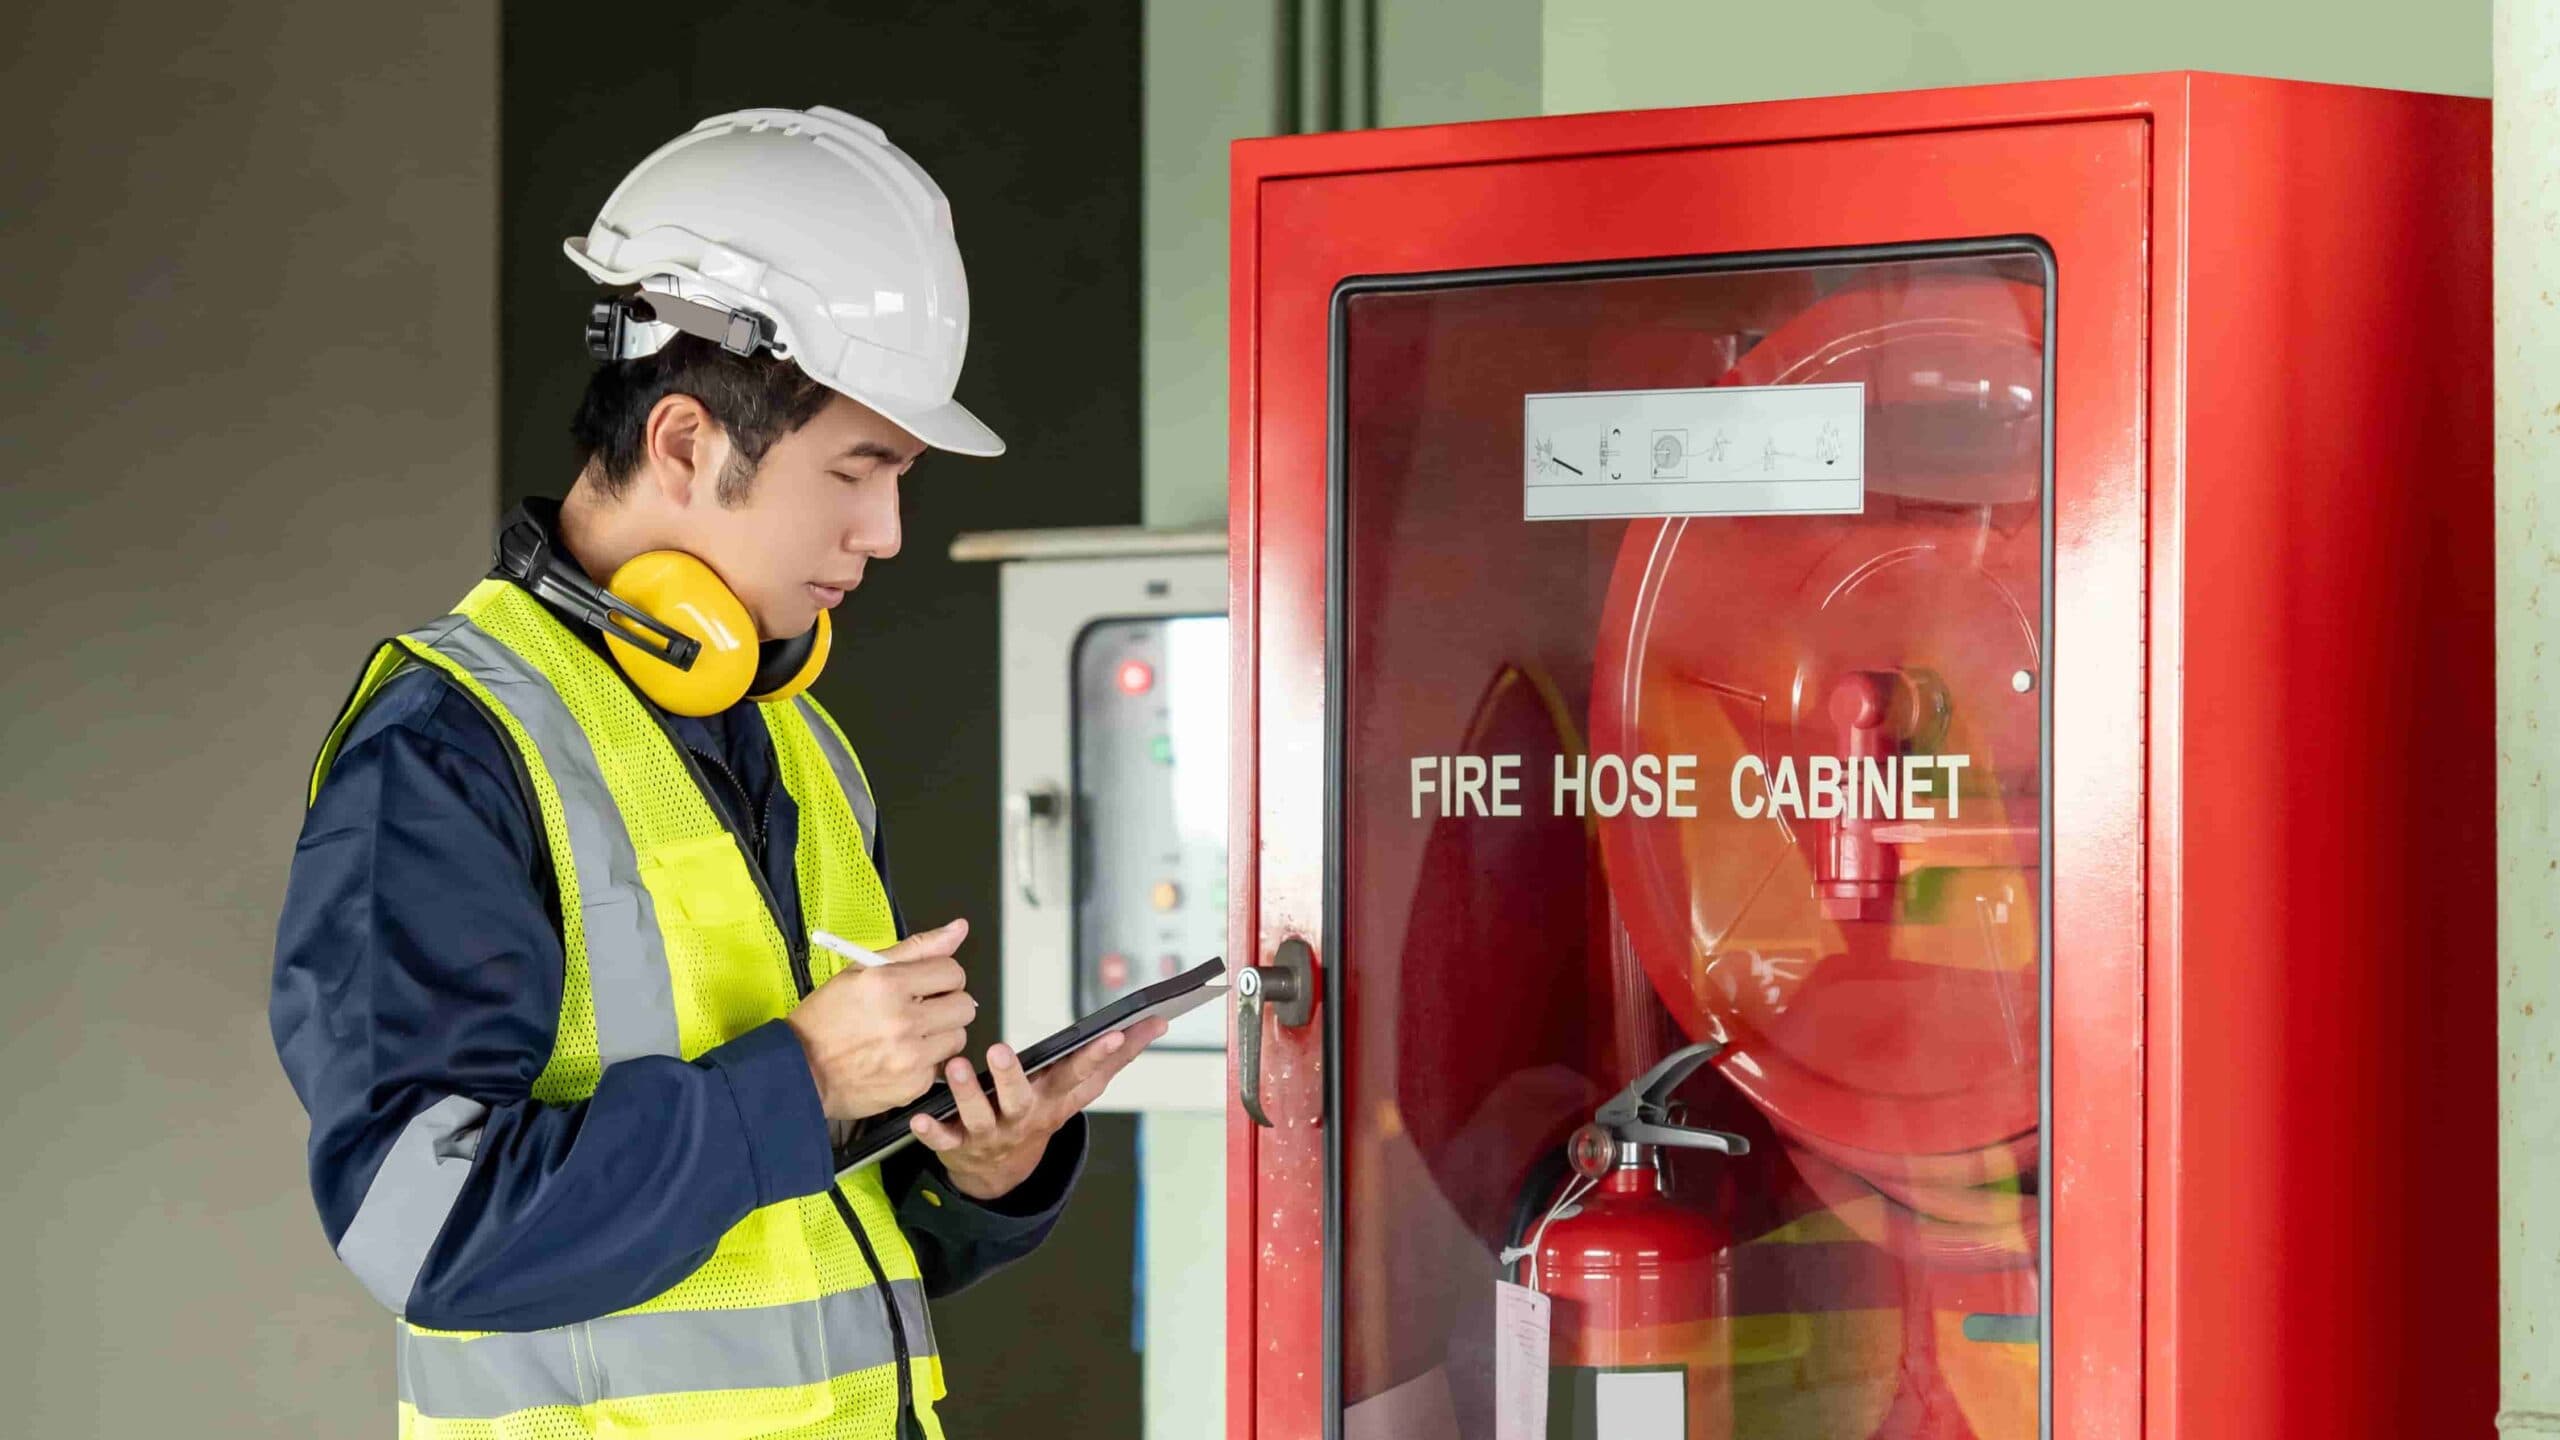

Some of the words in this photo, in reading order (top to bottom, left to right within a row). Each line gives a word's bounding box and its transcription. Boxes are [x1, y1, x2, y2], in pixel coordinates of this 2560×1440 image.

[1411, 755, 1521, 818] FIRE
[1554, 754, 1697, 818] HOSE
[1731, 754, 1970, 820] CABINET
